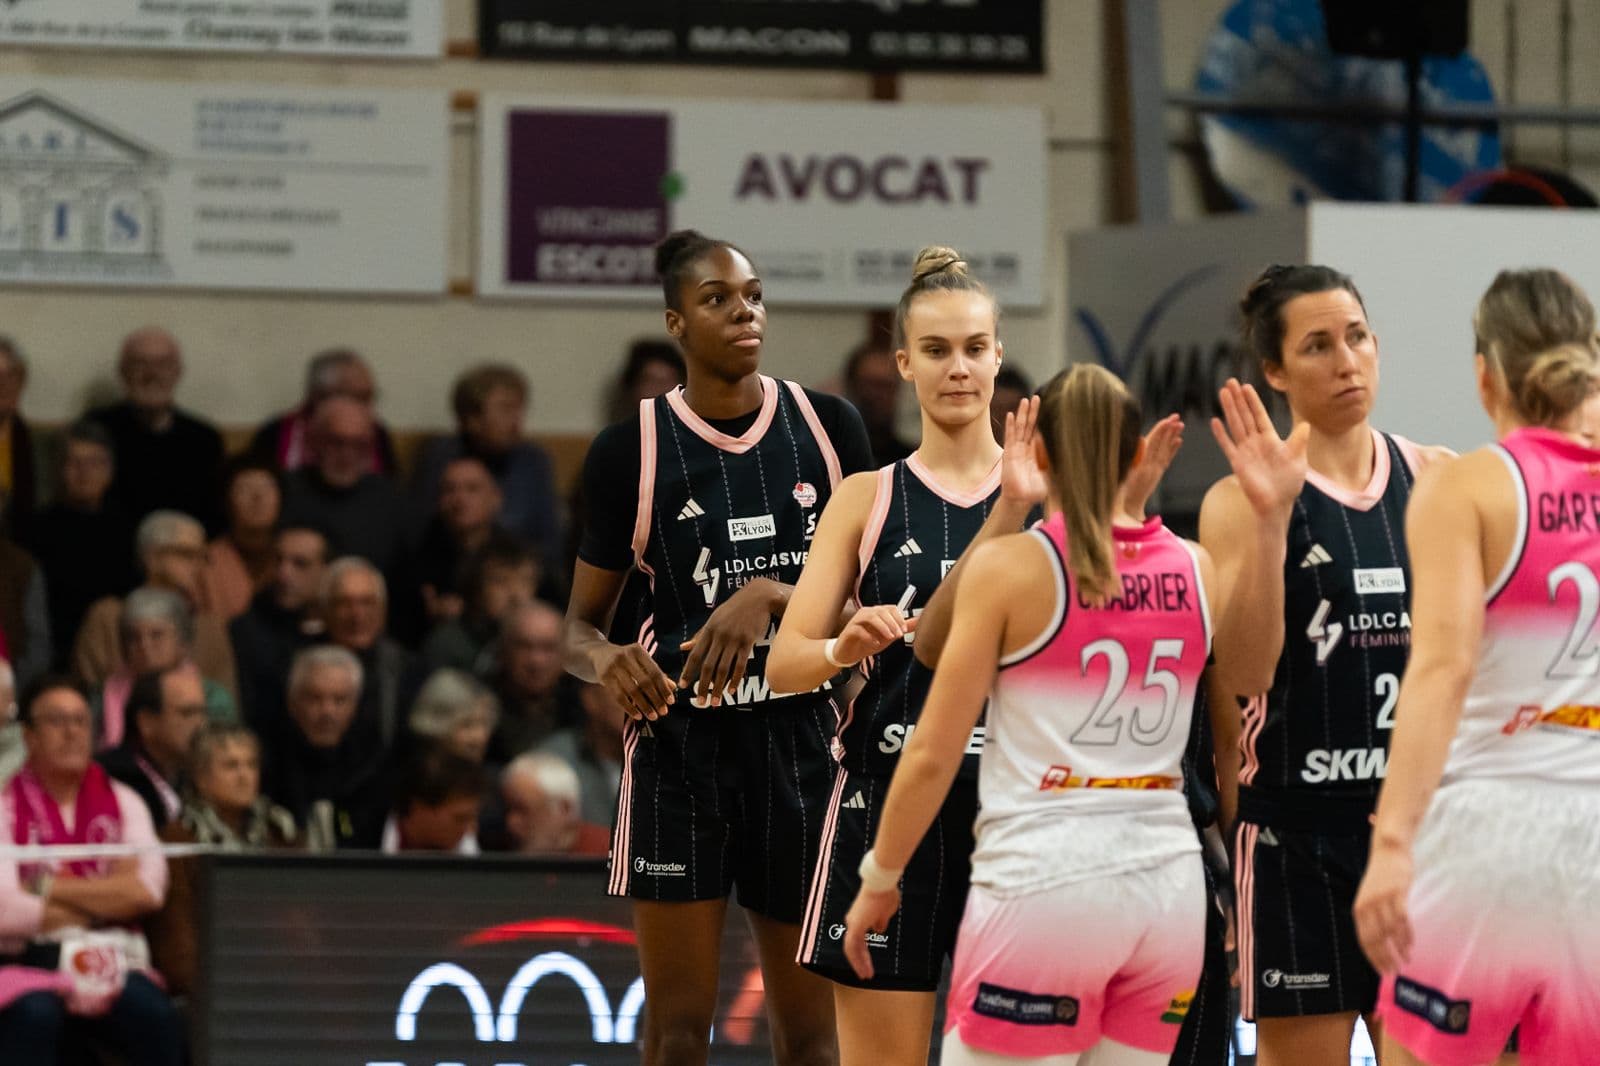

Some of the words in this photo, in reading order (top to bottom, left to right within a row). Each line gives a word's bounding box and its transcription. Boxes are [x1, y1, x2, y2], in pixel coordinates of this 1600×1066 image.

[735, 154, 990, 205] AVOCAT
[747, 523, 772, 536] LYON
[725, 556, 767, 574] LDLC
[769, 551, 809, 569] ASVE
[1077, 573, 1191, 612] ABRIER
[1349, 612, 1397, 631] LDLC
[1071, 638, 1184, 747] 25
[646, 861, 687, 872] transdev
